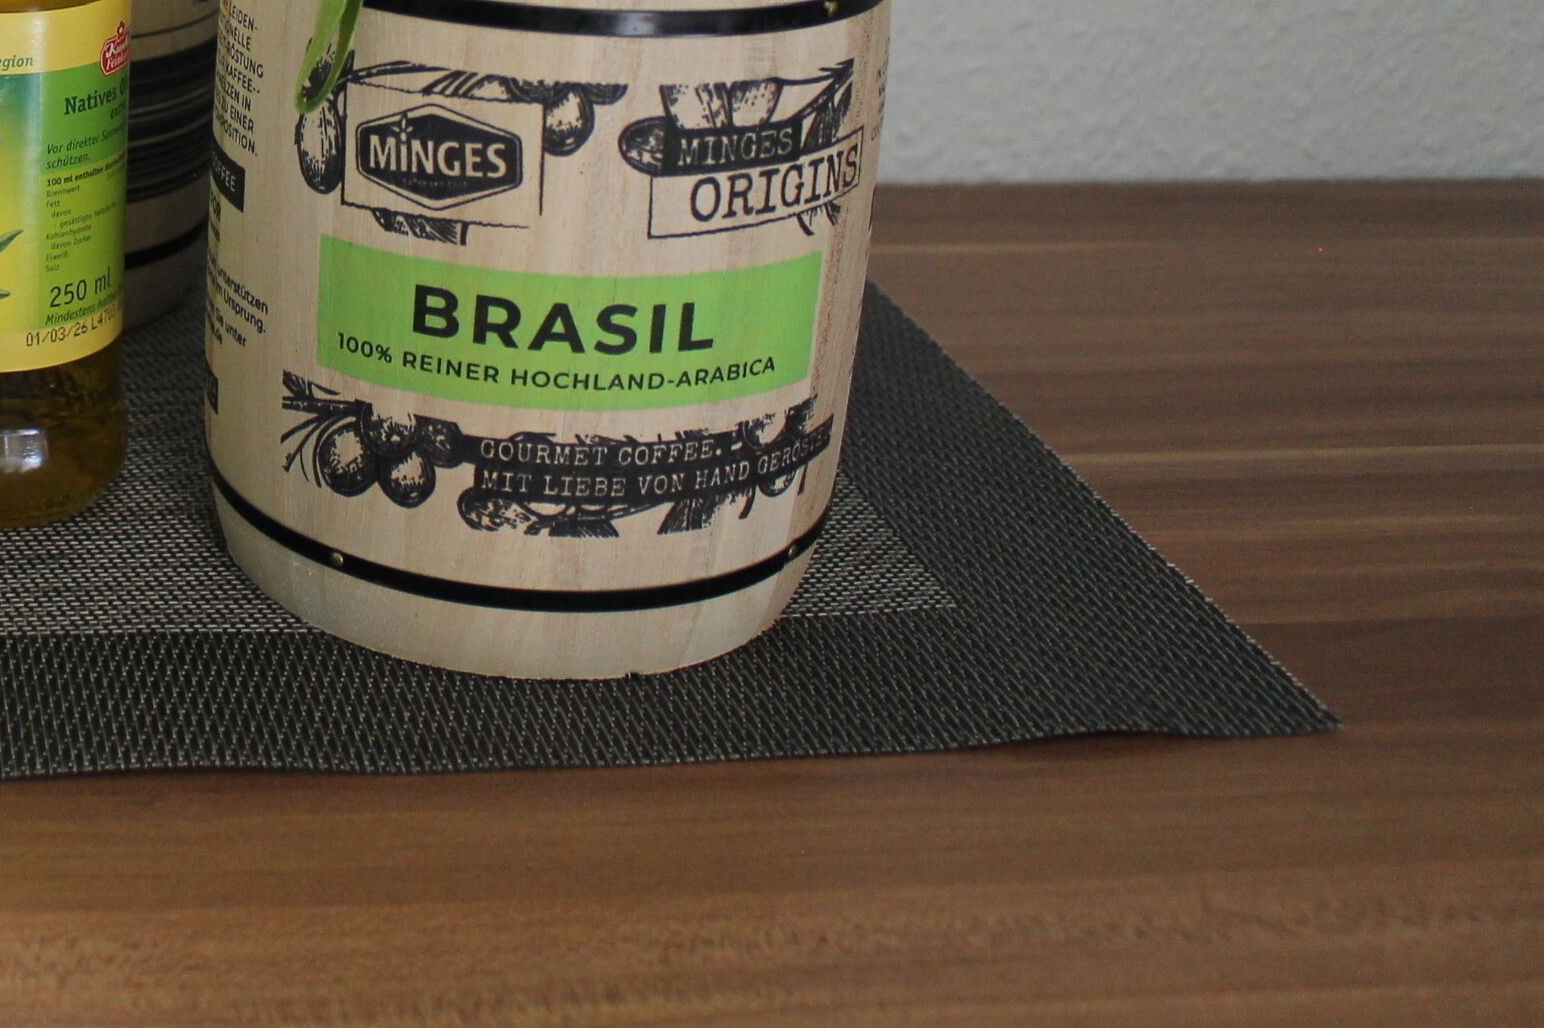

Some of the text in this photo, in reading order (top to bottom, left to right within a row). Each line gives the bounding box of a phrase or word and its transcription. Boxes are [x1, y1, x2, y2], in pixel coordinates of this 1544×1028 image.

[64, 86, 117, 116] Natives
[241, 97, 252, 113] IN
[229, 106, 255, 134] EINER
[47, 133, 100, 154] Vor direkter
[677, 127, 793, 166] MINGES
[45, 153, 91, 170] schützen.
[47, 178, 62, 188] 100
[690, 143, 859, 223] ORIGINS
[50, 279, 88, 308] 250
[94, 265, 112, 295] ml
[223, 287, 267, 335] Ursprung.
[412, 284, 715, 356] BRASIL
[26, 320, 89, 347] 01/03/26
[224, 322, 247, 348] unter
[337, 331, 776, 391] 100% REINER HOCHLAND-ARABICA
[480, 439, 723, 466] GOURMET COFFEE.
[481, 470, 533, 493] MIT
[543, 475, 627, 498] LIEBE
[637, 473, 685, 496] VON
[694, 460, 751, 491] HAND
